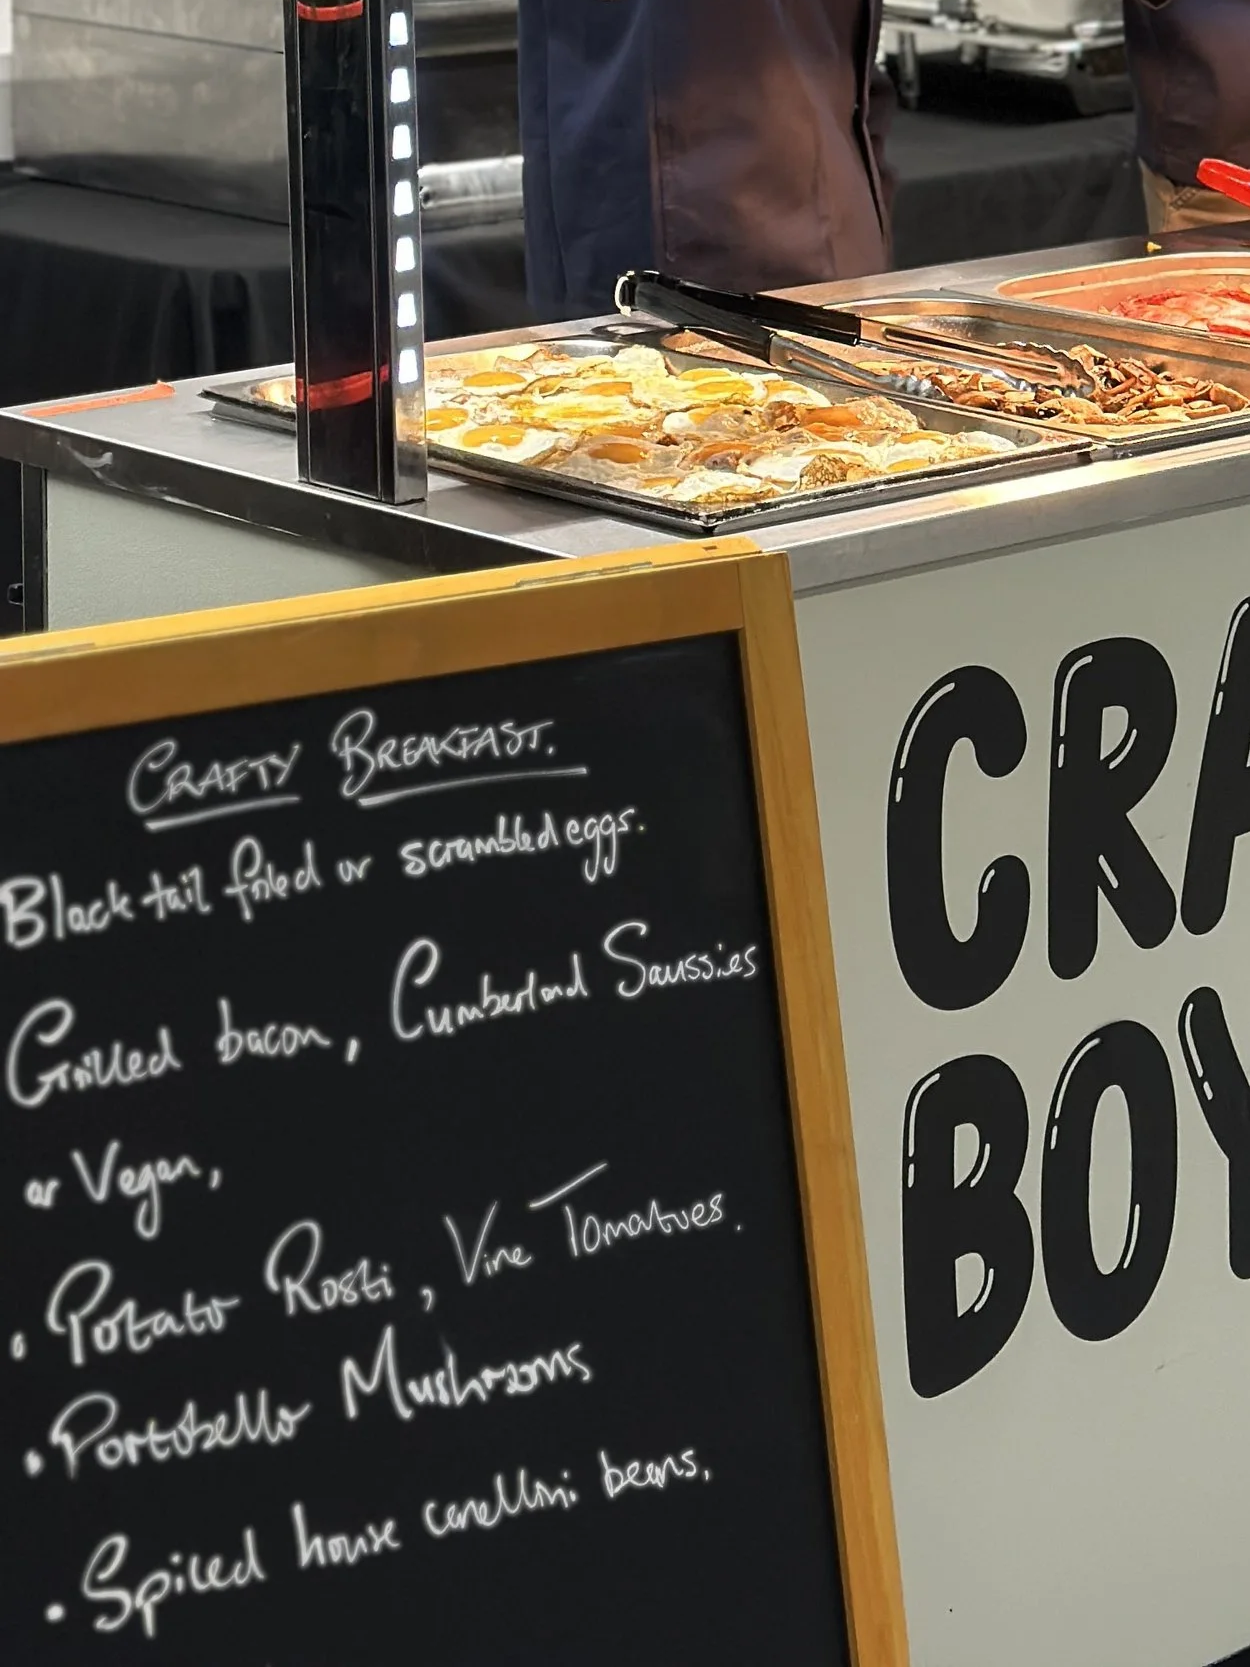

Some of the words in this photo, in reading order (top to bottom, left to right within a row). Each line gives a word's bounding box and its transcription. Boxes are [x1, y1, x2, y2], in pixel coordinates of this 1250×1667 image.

[126, 738, 301, 816] CRAFTY
[223, 834, 322, 922] fried
[336, 856, 372, 885] or
[6, 997, 182, 1109] Grilled
[390, 936, 589, 1042] Cumberland
[45, 1258, 241, 1368] Potato
[443, 1200, 534, 1286] Vine
[340, 1323, 594, 1421] Mushrooms
[80, 1527, 267, 1639] Spiced
[290, 1500, 401, 1569] house
